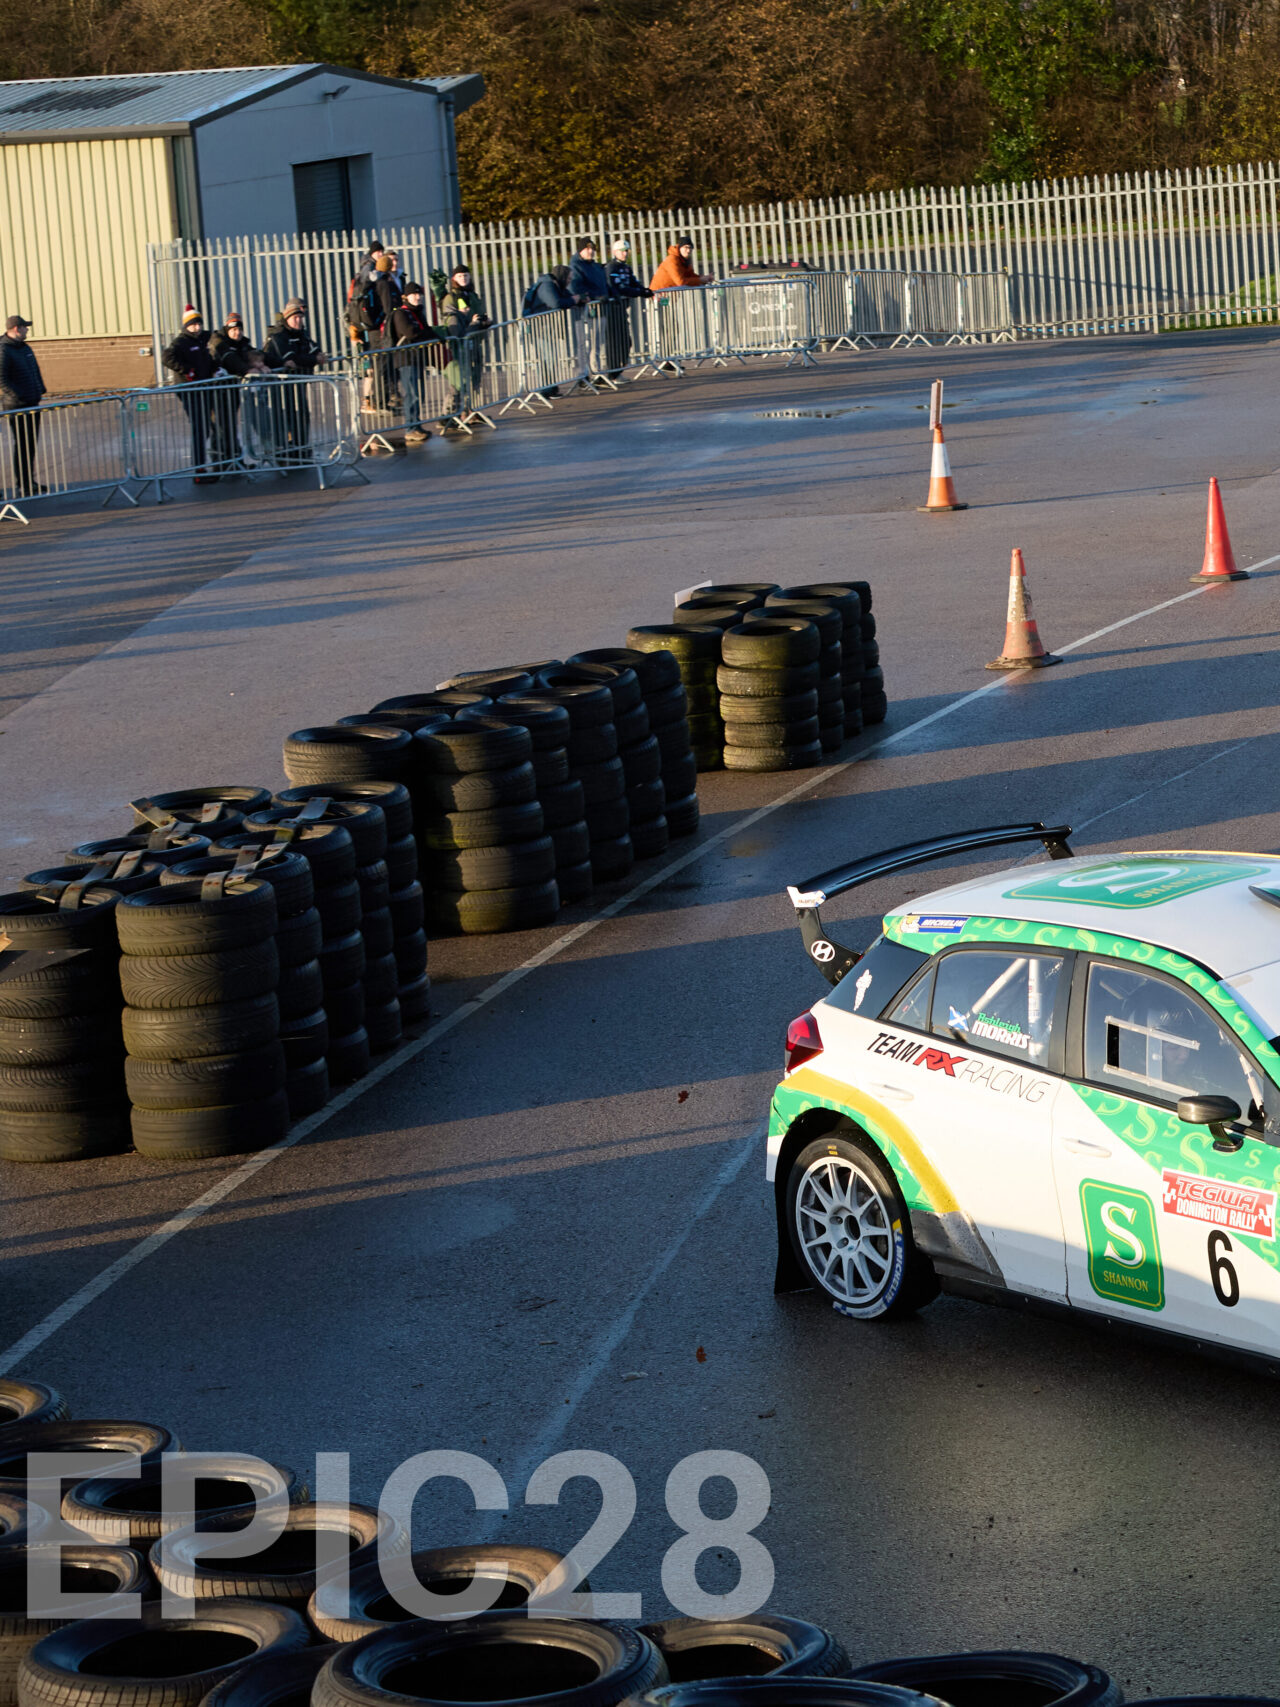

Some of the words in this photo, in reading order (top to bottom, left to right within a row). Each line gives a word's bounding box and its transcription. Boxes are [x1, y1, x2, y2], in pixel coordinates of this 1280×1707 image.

[921, 918, 967, 928] MICHELIN
[971, 1022, 1032, 1050] MORRIS
[977, 1012, 1022, 1034] Ashleigh
[866, 1032, 924, 1063] TEAM
[958, 1059, 1051, 1104] RACING
[1175, 1176, 1260, 1213] TEGIWA
[1176, 1197, 1229, 1226] DONINGTON
[1228, 1209, 1258, 1231] RALLY
[884, 1245, 904, 1304] MICHELIN
[1102, 1269, 1150, 1293] SHANNON
[1207, 1229, 1240, 1308] 6
